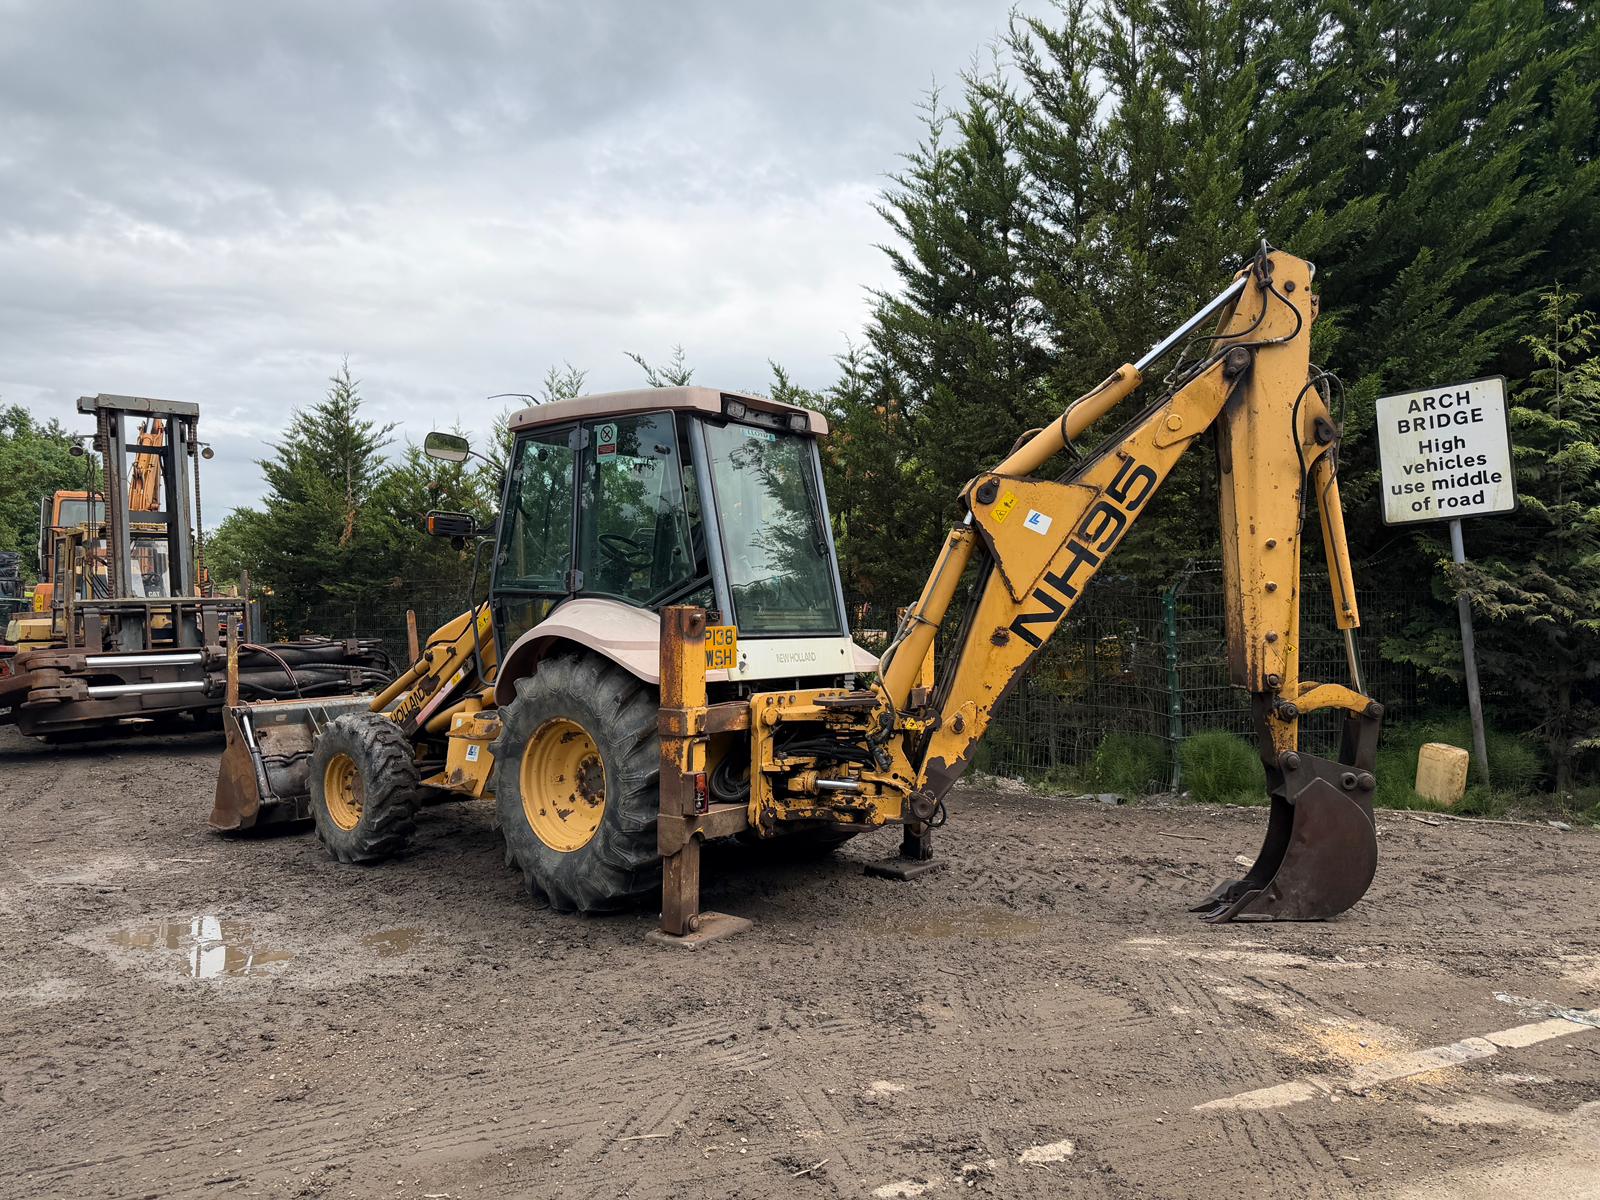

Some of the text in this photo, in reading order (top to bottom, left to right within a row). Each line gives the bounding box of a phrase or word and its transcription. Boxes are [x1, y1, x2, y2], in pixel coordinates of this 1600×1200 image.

[1408, 390, 1470, 414] ARCH
[1398, 408, 1484, 434] BRIDGE
[1419, 436, 1466, 455] High
[1403, 454, 1487, 475] vehicles
[1391, 470, 1502, 496] use middle
[1411, 490, 1485, 512] of road
[1009, 455, 1158, 649] NH95
[705, 648, 732, 667] WSH
